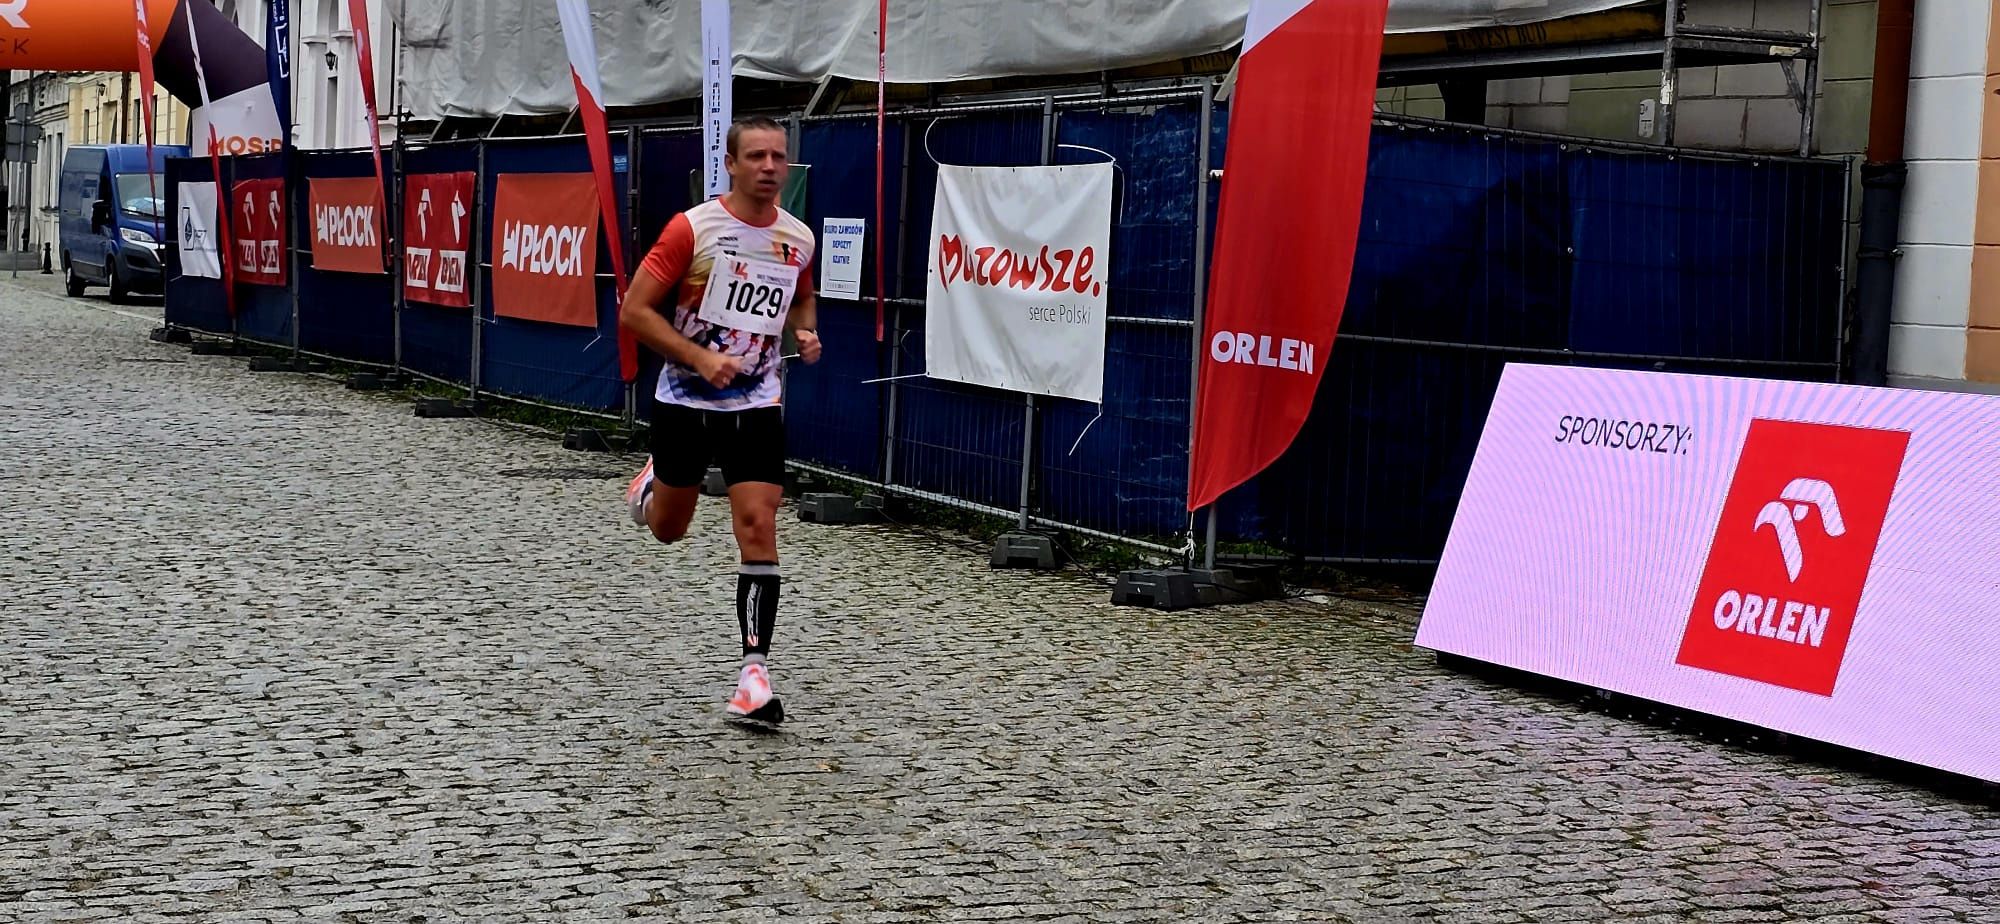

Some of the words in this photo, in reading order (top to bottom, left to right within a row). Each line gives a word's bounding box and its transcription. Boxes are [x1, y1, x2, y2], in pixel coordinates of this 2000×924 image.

[0, 37, 30, 55] K
[328, 205, 376, 247] PŁOCK
[519, 224, 587, 276] PŁOCK
[725, 280, 783, 319] 1029
[1029, 306, 1056, 322] serce
[1059, 304, 1092, 325] Polski
[1211, 330, 1314, 375] ORLEN
[1555, 415, 1693, 455] SPONSORZY:
[1713, 589, 1830, 648] ORLEN
